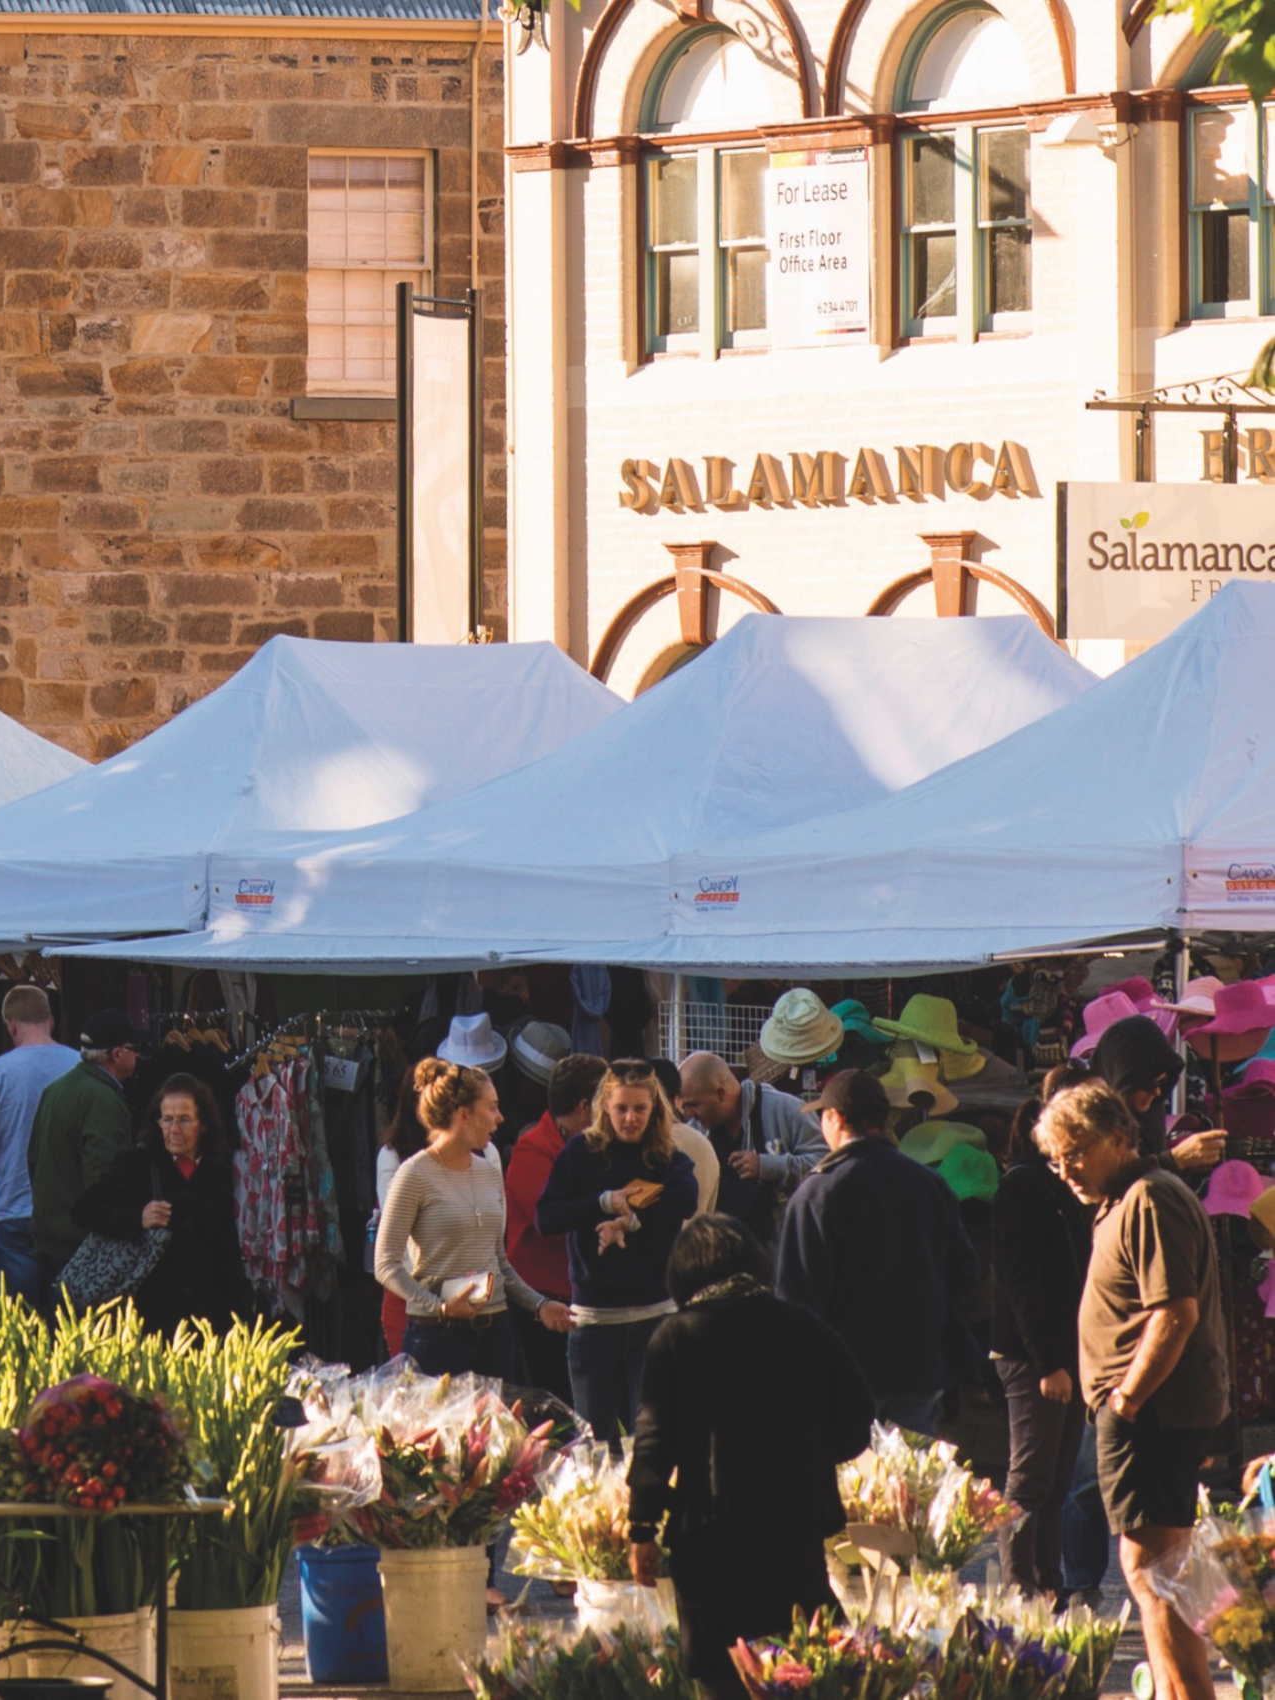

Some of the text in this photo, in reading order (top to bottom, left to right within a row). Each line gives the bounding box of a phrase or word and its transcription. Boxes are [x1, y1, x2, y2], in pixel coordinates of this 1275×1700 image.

[777, 179, 848, 205] For Lease
[779, 229, 842, 249] First Floor
[780, 253, 847, 273] Office Area
[619, 440, 1041, 515] SALAMANCA
